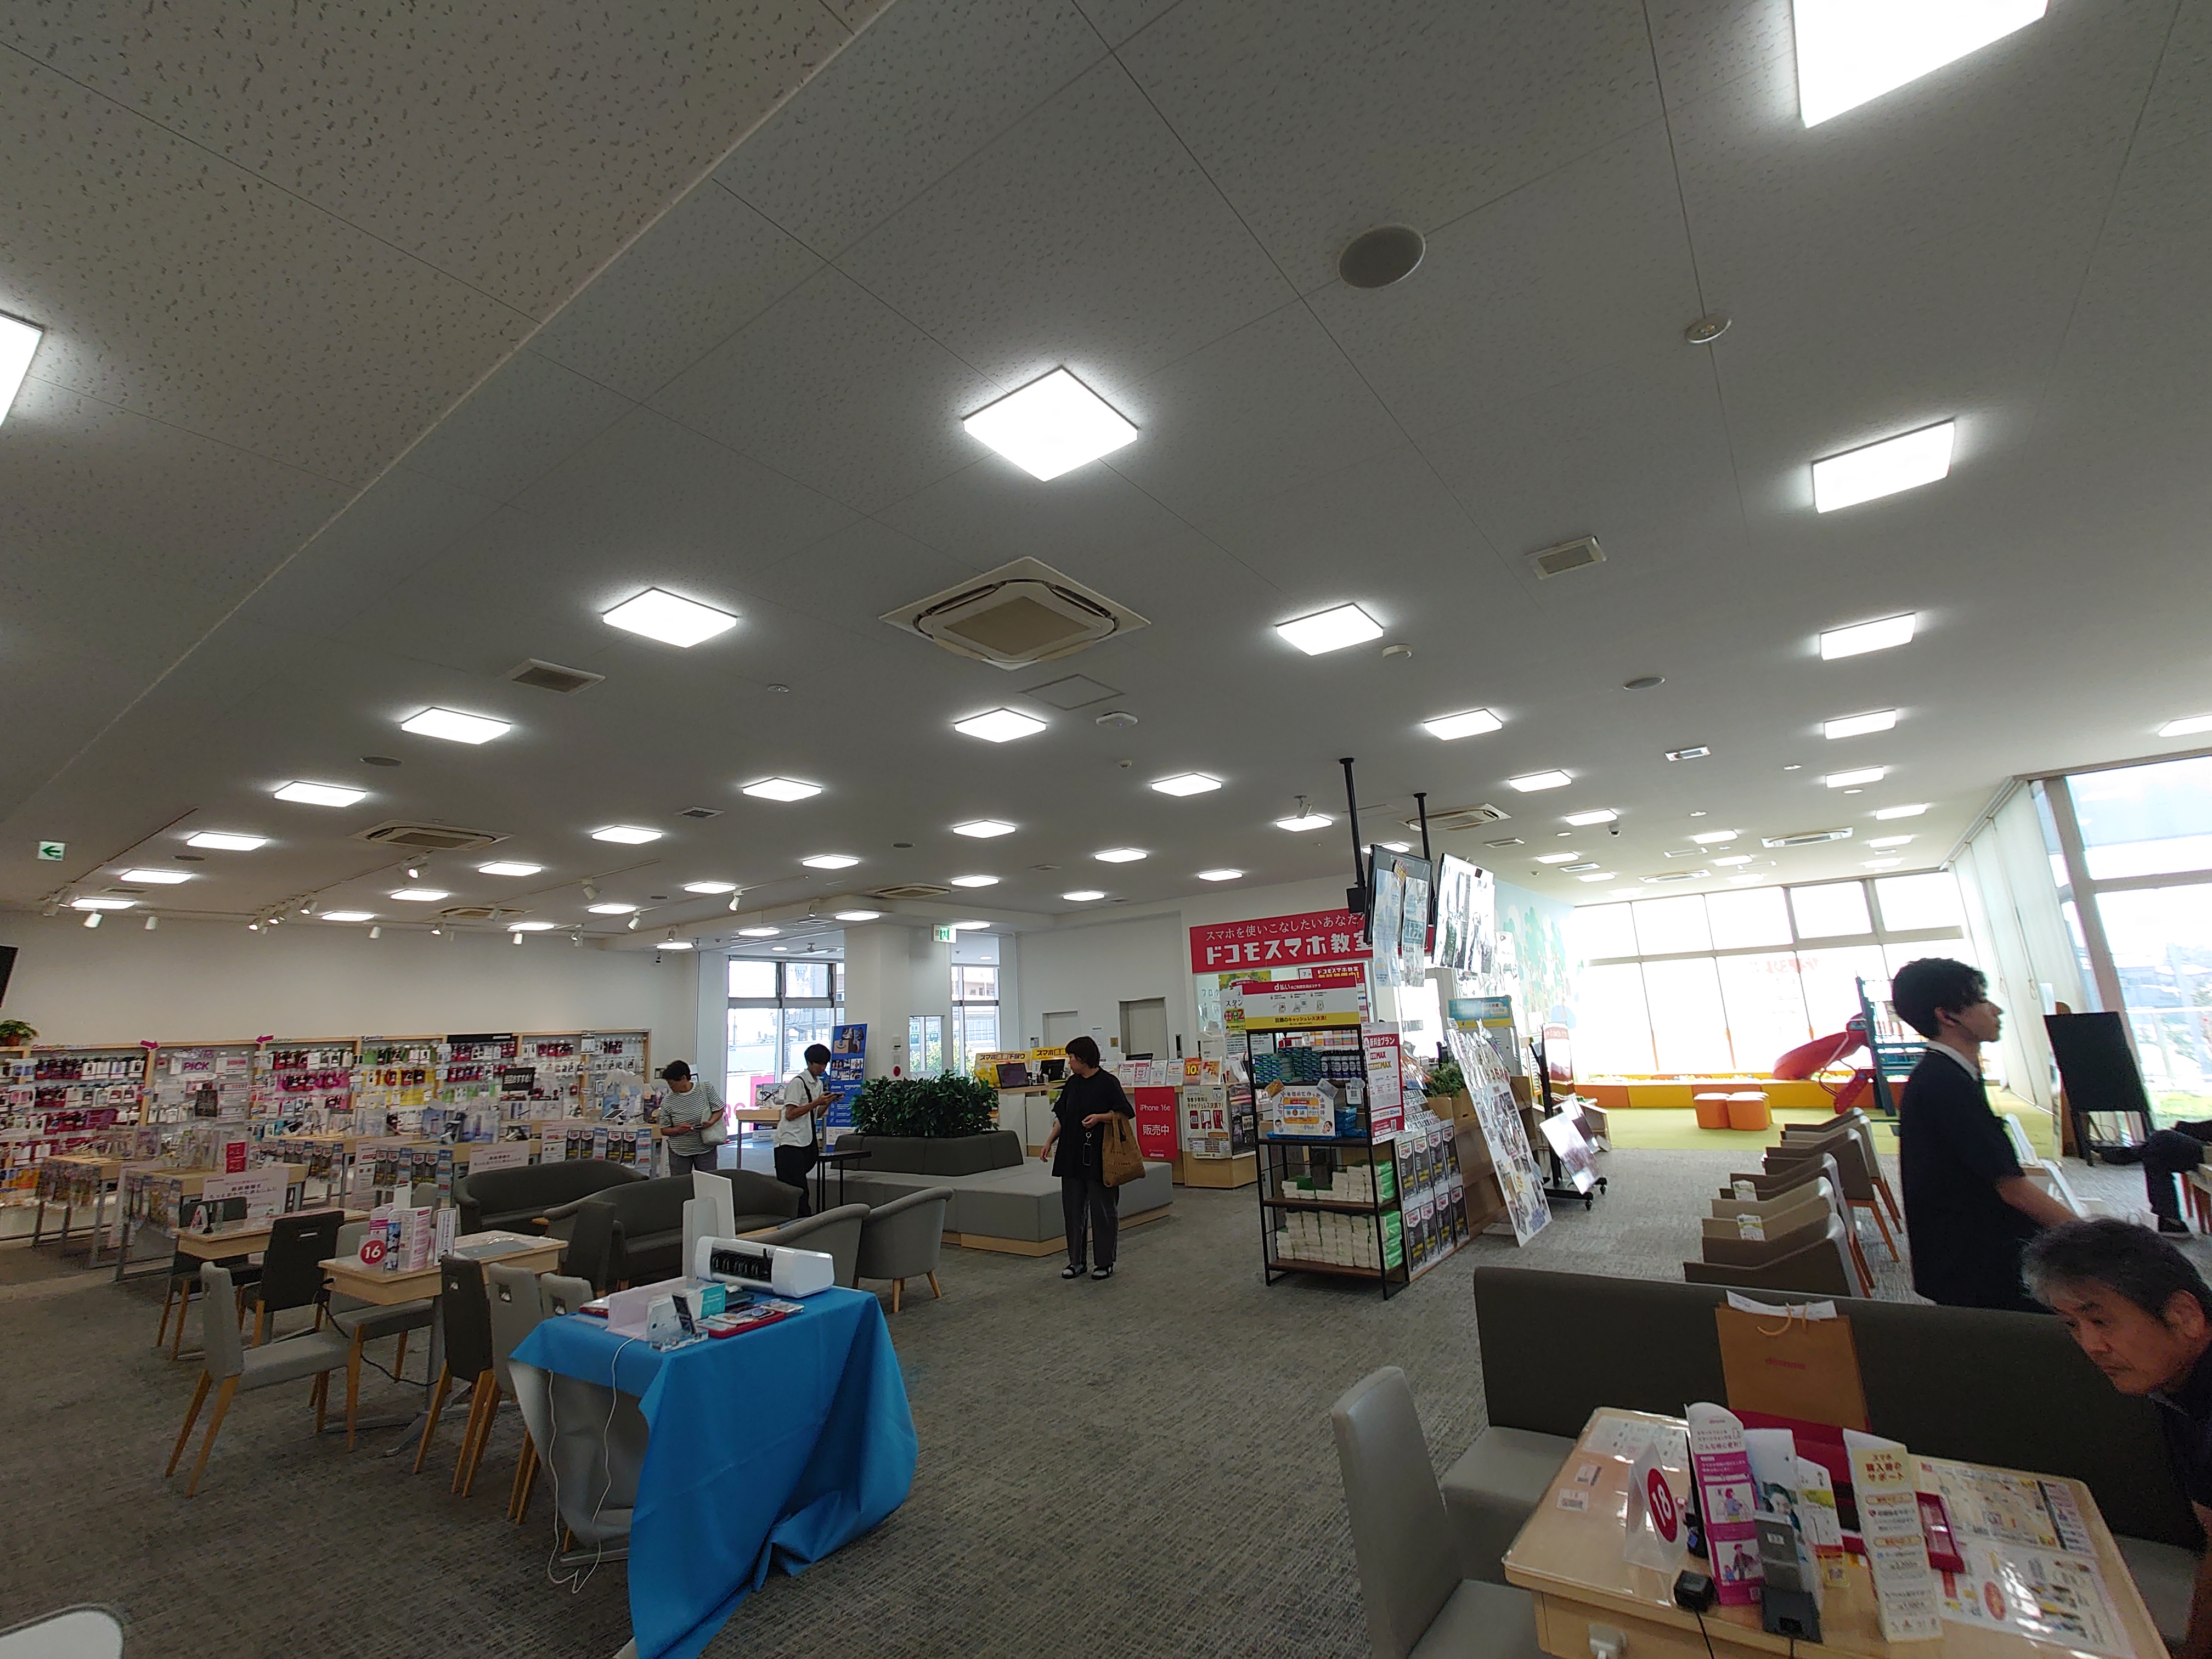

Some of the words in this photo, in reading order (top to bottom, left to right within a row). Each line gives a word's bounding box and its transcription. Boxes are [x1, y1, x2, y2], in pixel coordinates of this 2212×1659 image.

[1206, 930, 1373, 965] ドコモスマホ教室
[1369, 1036, 1395, 1047] 新料金プラン
[183, 1062, 210, 1070] PICK
[1143, 1124, 1170, 1136] 販売中
[365, 1245, 382, 1259] 16
[1651, 1483, 1672, 1528] 18
